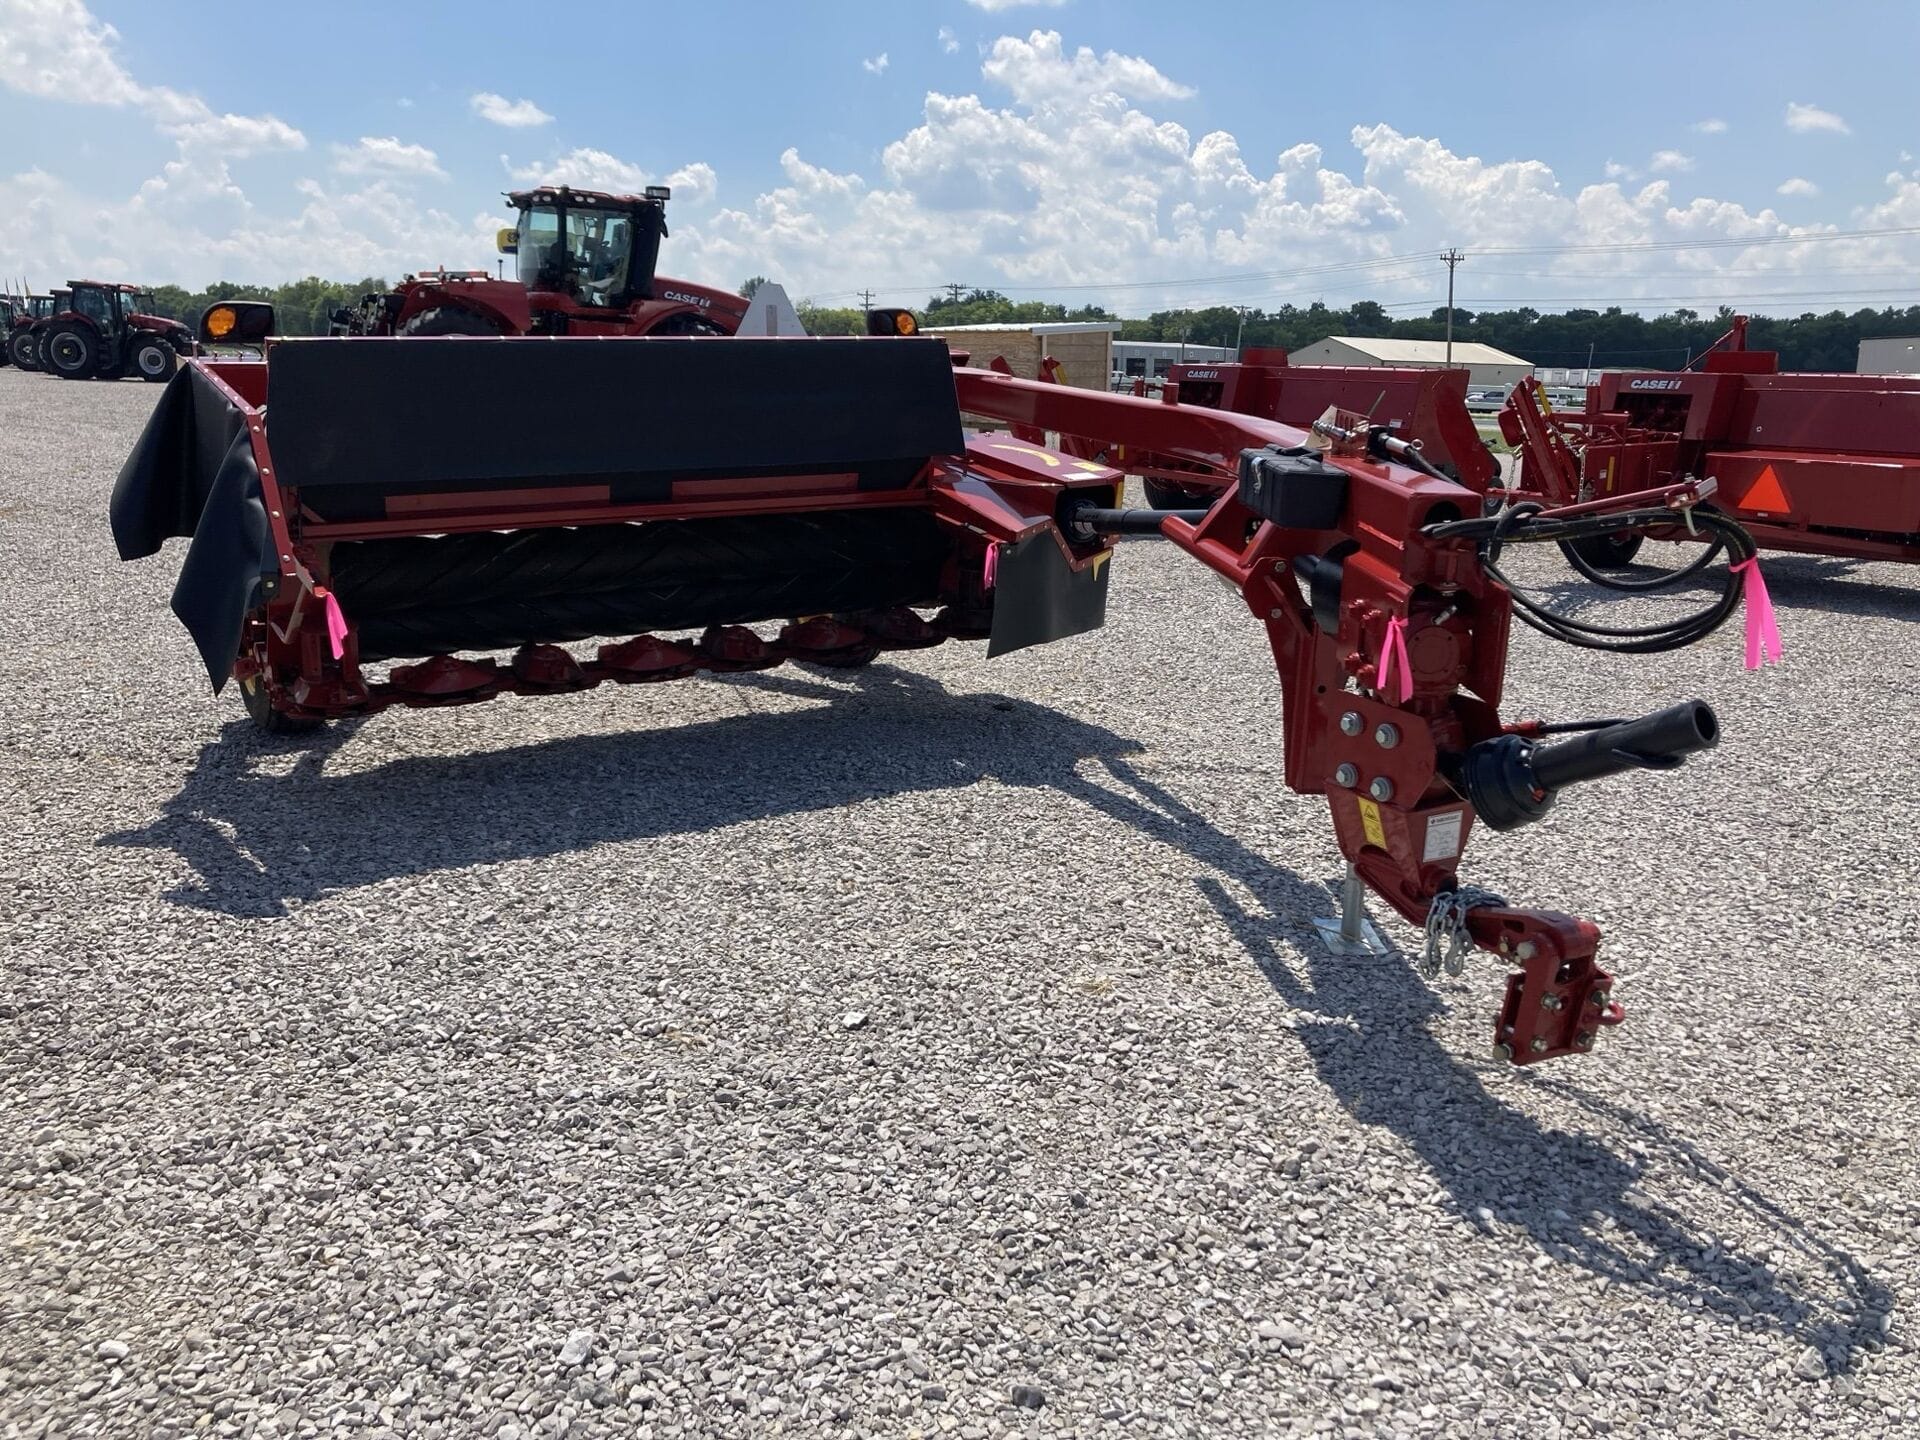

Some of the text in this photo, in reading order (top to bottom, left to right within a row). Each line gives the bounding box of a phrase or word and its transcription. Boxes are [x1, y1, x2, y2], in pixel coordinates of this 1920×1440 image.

[664, 291, 699, 304] CASE
[1187, 370, 1210, 378] CASE
[1631, 380, 1668, 389] CASE
